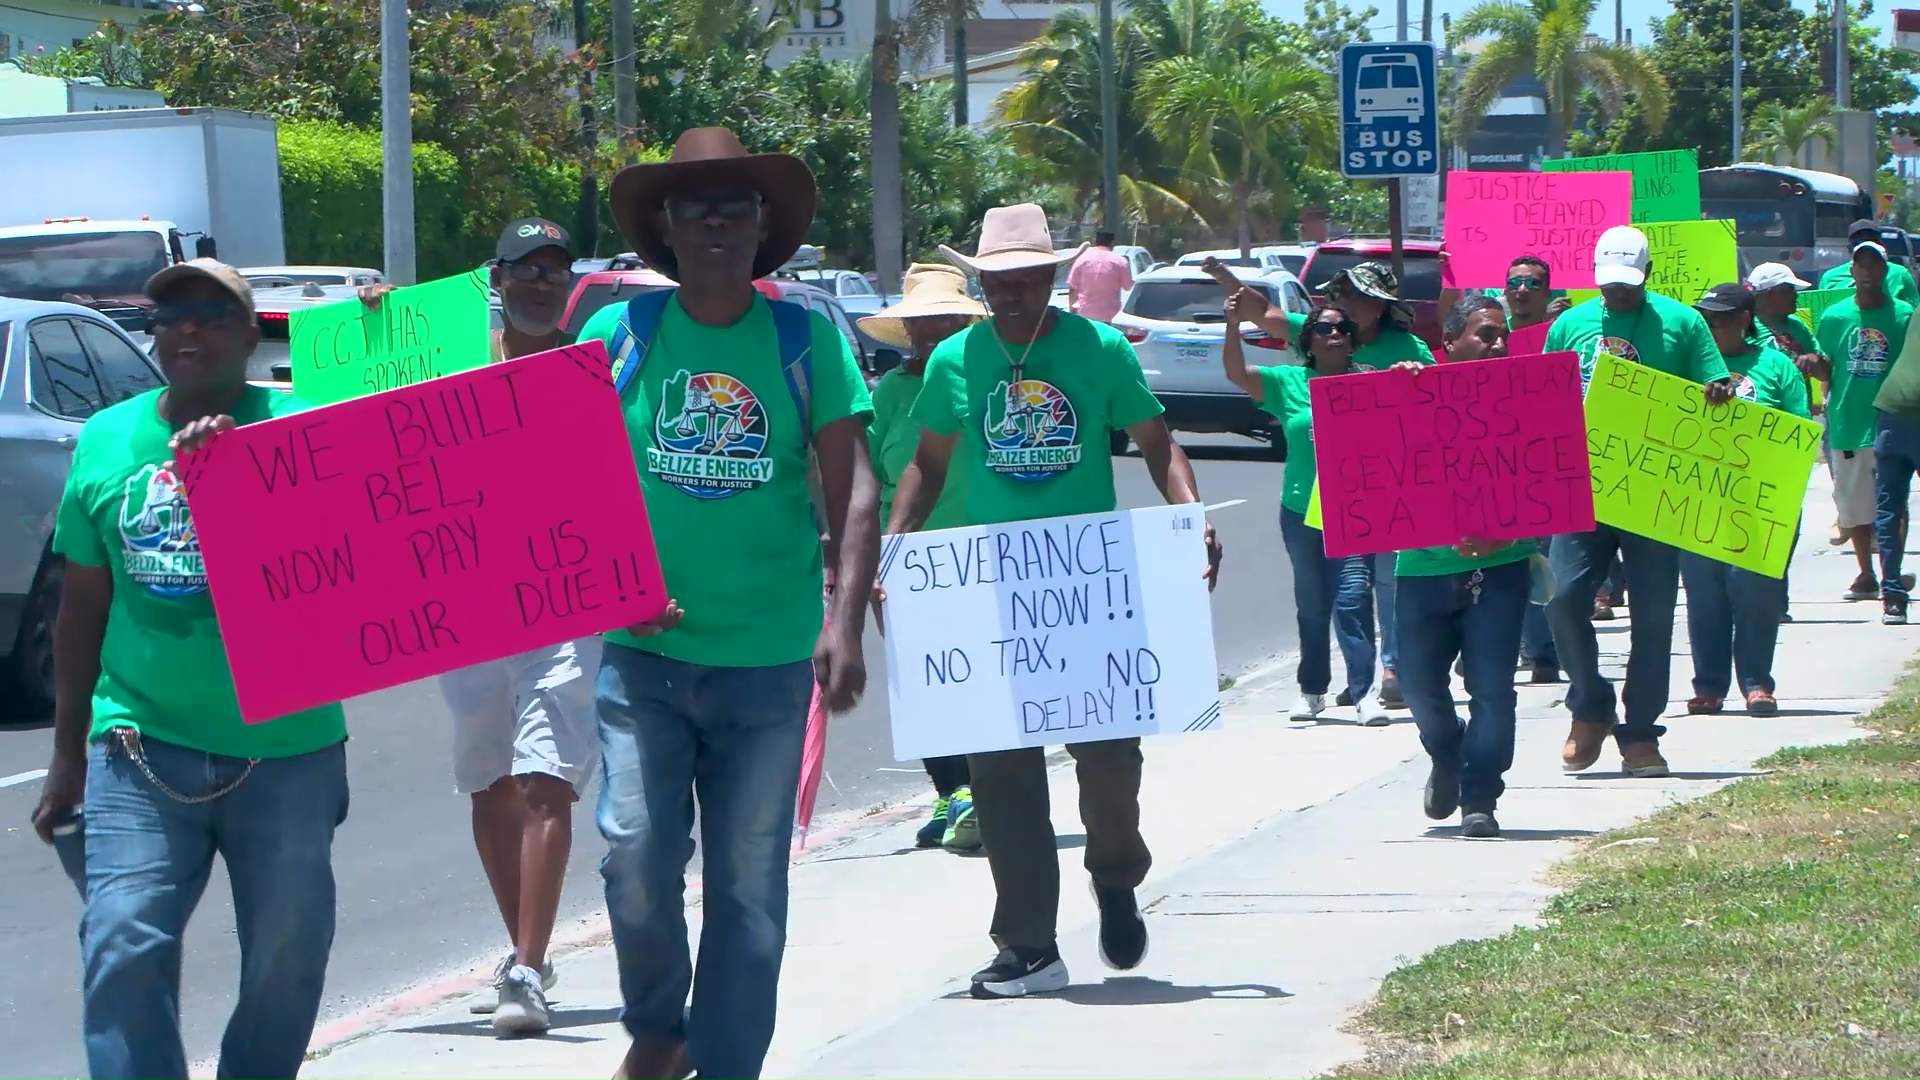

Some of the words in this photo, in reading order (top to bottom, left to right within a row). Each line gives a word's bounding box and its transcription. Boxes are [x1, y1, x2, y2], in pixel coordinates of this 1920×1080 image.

[1349, 150, 1433, 168] STOP
[1359, 129, 1423, 148] BUS
[1470, 153, 1524, 163] RIDGELINE
[1654, 152, 1681, 174] THE
[1464, 174, 1557, 201] JUSTICE
[1632, 176, 1676, 199] LING,
[1513, 199, 1606, 226] DELAYED
[1462, 226, 1488, 242] IS
[1635, 224, 1681, 248] ATE
[389, 299, 430, 352] HAS
[1412, 366, 1491, 405] STOP
[1505, 362, 1577, 402] PLAY
[246, 420, 344, 493] WE
[384, 369, 525, 459] BUILT
[1644, 409, 1753, 469] LOSS
[1758, 411, 1820, 452] PLAY
[649, 453, 701, 475] BELIZE
[705, 457, 771, 479] ENERGY
[1030, 447, 1079, 463] ENERGY
[1338, 434, 1577, 494] SEVERANCE
[1587, 428, 1777, 514] SEVERANCE
[363, 456, 485, 523] BEL,
[662, 474, 699, 486] WORKERS
[701, 479, 718, 487] FOR
[720, 480, 753, 489] JUSTICE
[1339, 500, 1372, 544] IS
[1387, 496, 1417, 535] A
[1451, 475, 1586, 532] MUST
[1607, 475, 1631, 504] A
[1654, 489, 1788, 561] MUST
[261, 534, 355, 602] NOW
[408, 516, 481, 578] PAY
[527, 519, 589, 572] US
[904, 519, 1125, 592] SEVERANCE
[358, 600, 461, 666] OUR
[925, 648, 971, 687] NO
[990, 634, 1066, 677] TAX,
[1107, 648, 1161, 688] NO
